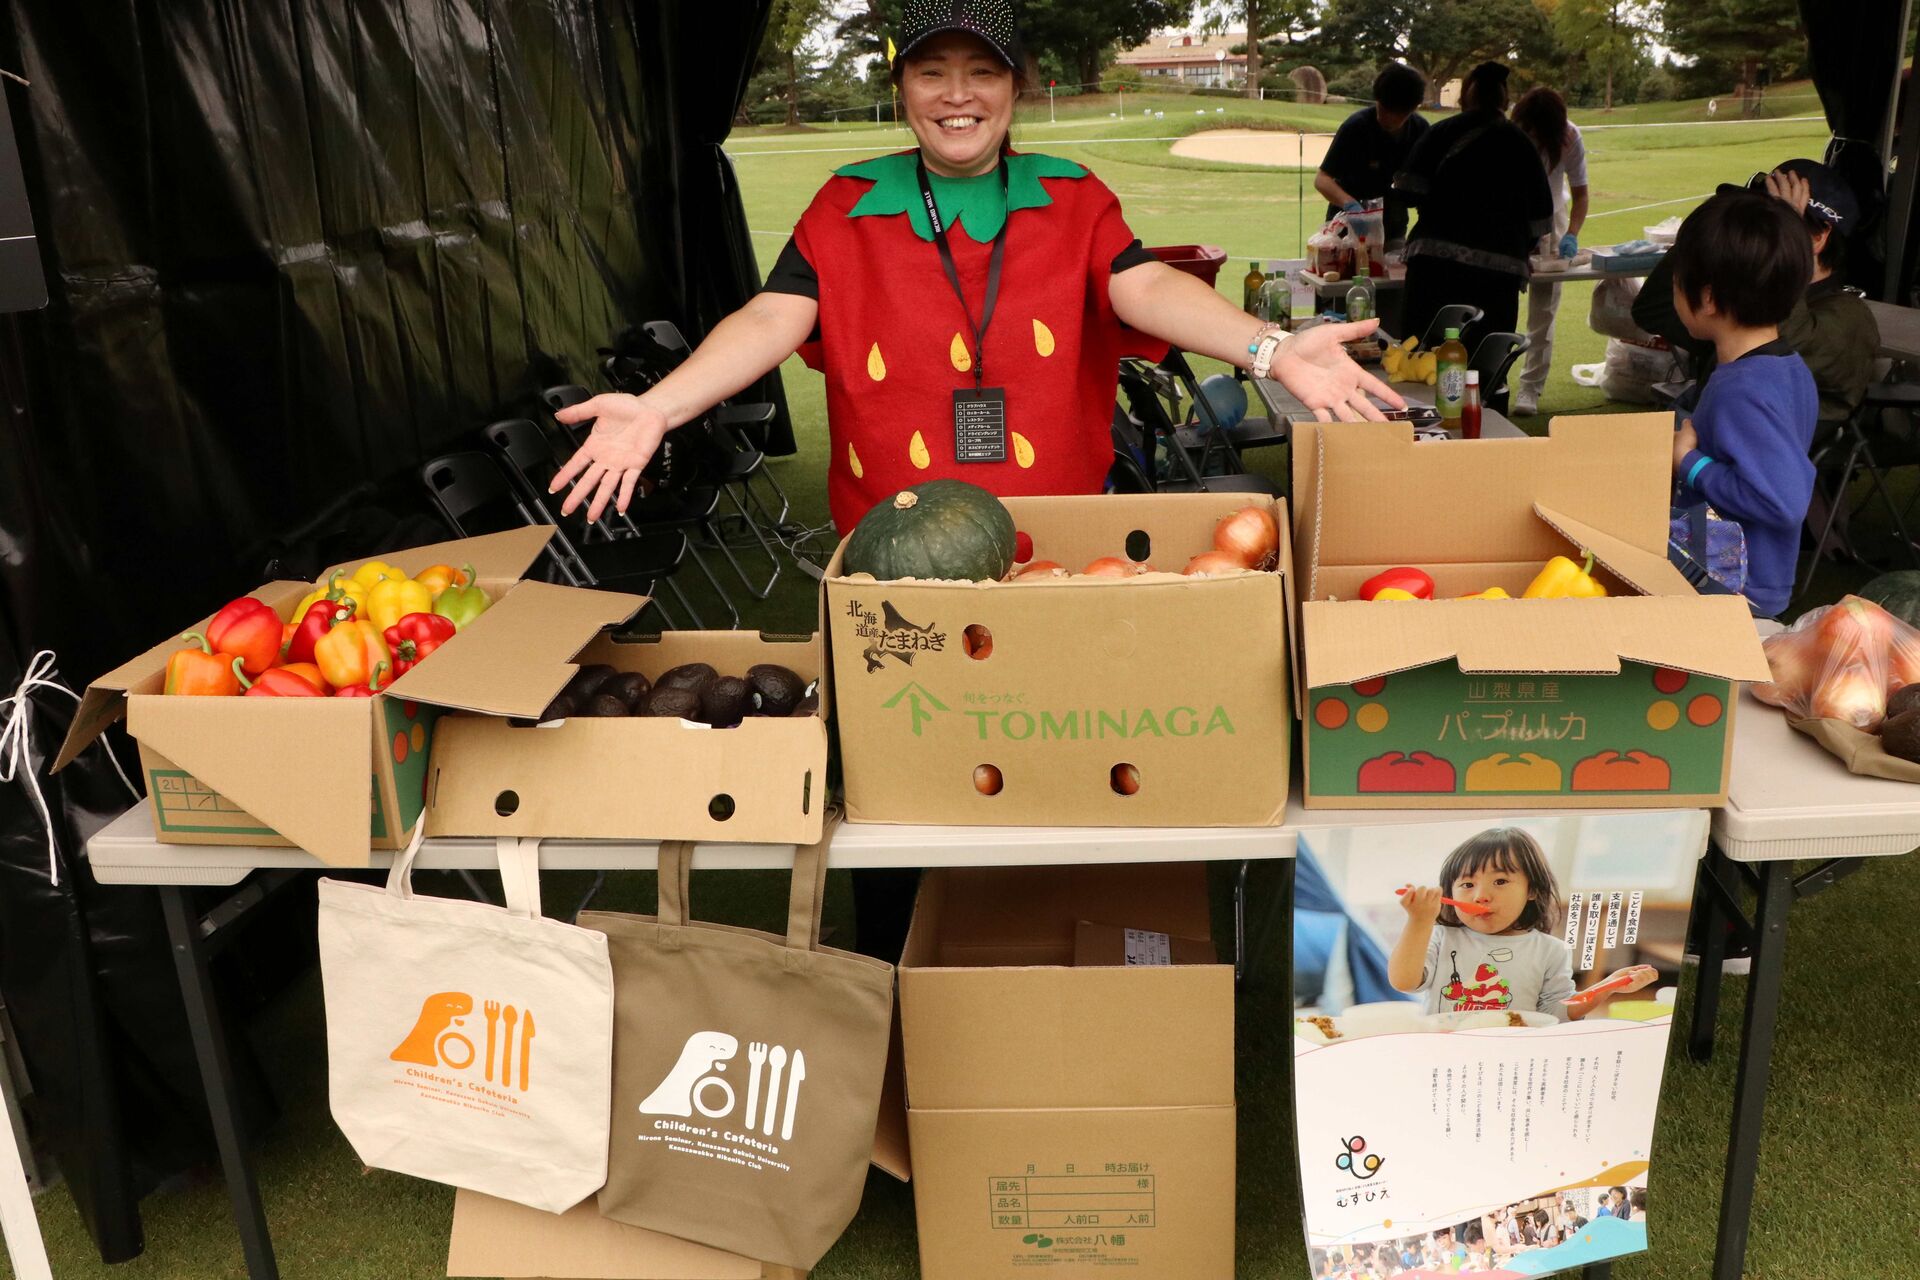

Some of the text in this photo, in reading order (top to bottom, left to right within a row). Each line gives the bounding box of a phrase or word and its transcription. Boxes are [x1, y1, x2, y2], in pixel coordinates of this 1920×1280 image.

[924, 190, 942, 233] RICHARD MILLE
[963, 691, 1025, 704] 旬をつなぐ
[1468, 681, 1560, 699] 山梨県産
[963, 705, 1236, 741] TOMINAGA
[1437, 709, 1586, 741] パプリカ
[162, 779, 180, 790] 2L
[1605, 892, 1622, 948] 支援を通じて、
[1625, 892, 1641, 943] こども食堂の
[1582, 893, 1601, 969] 誰も取りこぼさない
[406, 1068, 518, 1105] Children's Cafeteria
[654, 1119, 779, 1155] Children's Cafeteria
[697, 1141, 731, 1153] Kanazawa
[757, 1155, 791, 1172] University
[747, 1161, 762, 1170] Club
[1026, 1162, 1150, 1174] 月 日 時お届け
[996, 1178, 1149, 1192] 届先 様
[997, 1198, 1021, 1208] 品名
[1336, 1187, 1391, 1208] むすびえ
[998, 1215, 1022, 1225] 数量
[1126, 1214, 1149, 1224] 人前
[1056, 1236, 1093, 1245] 株式会社
